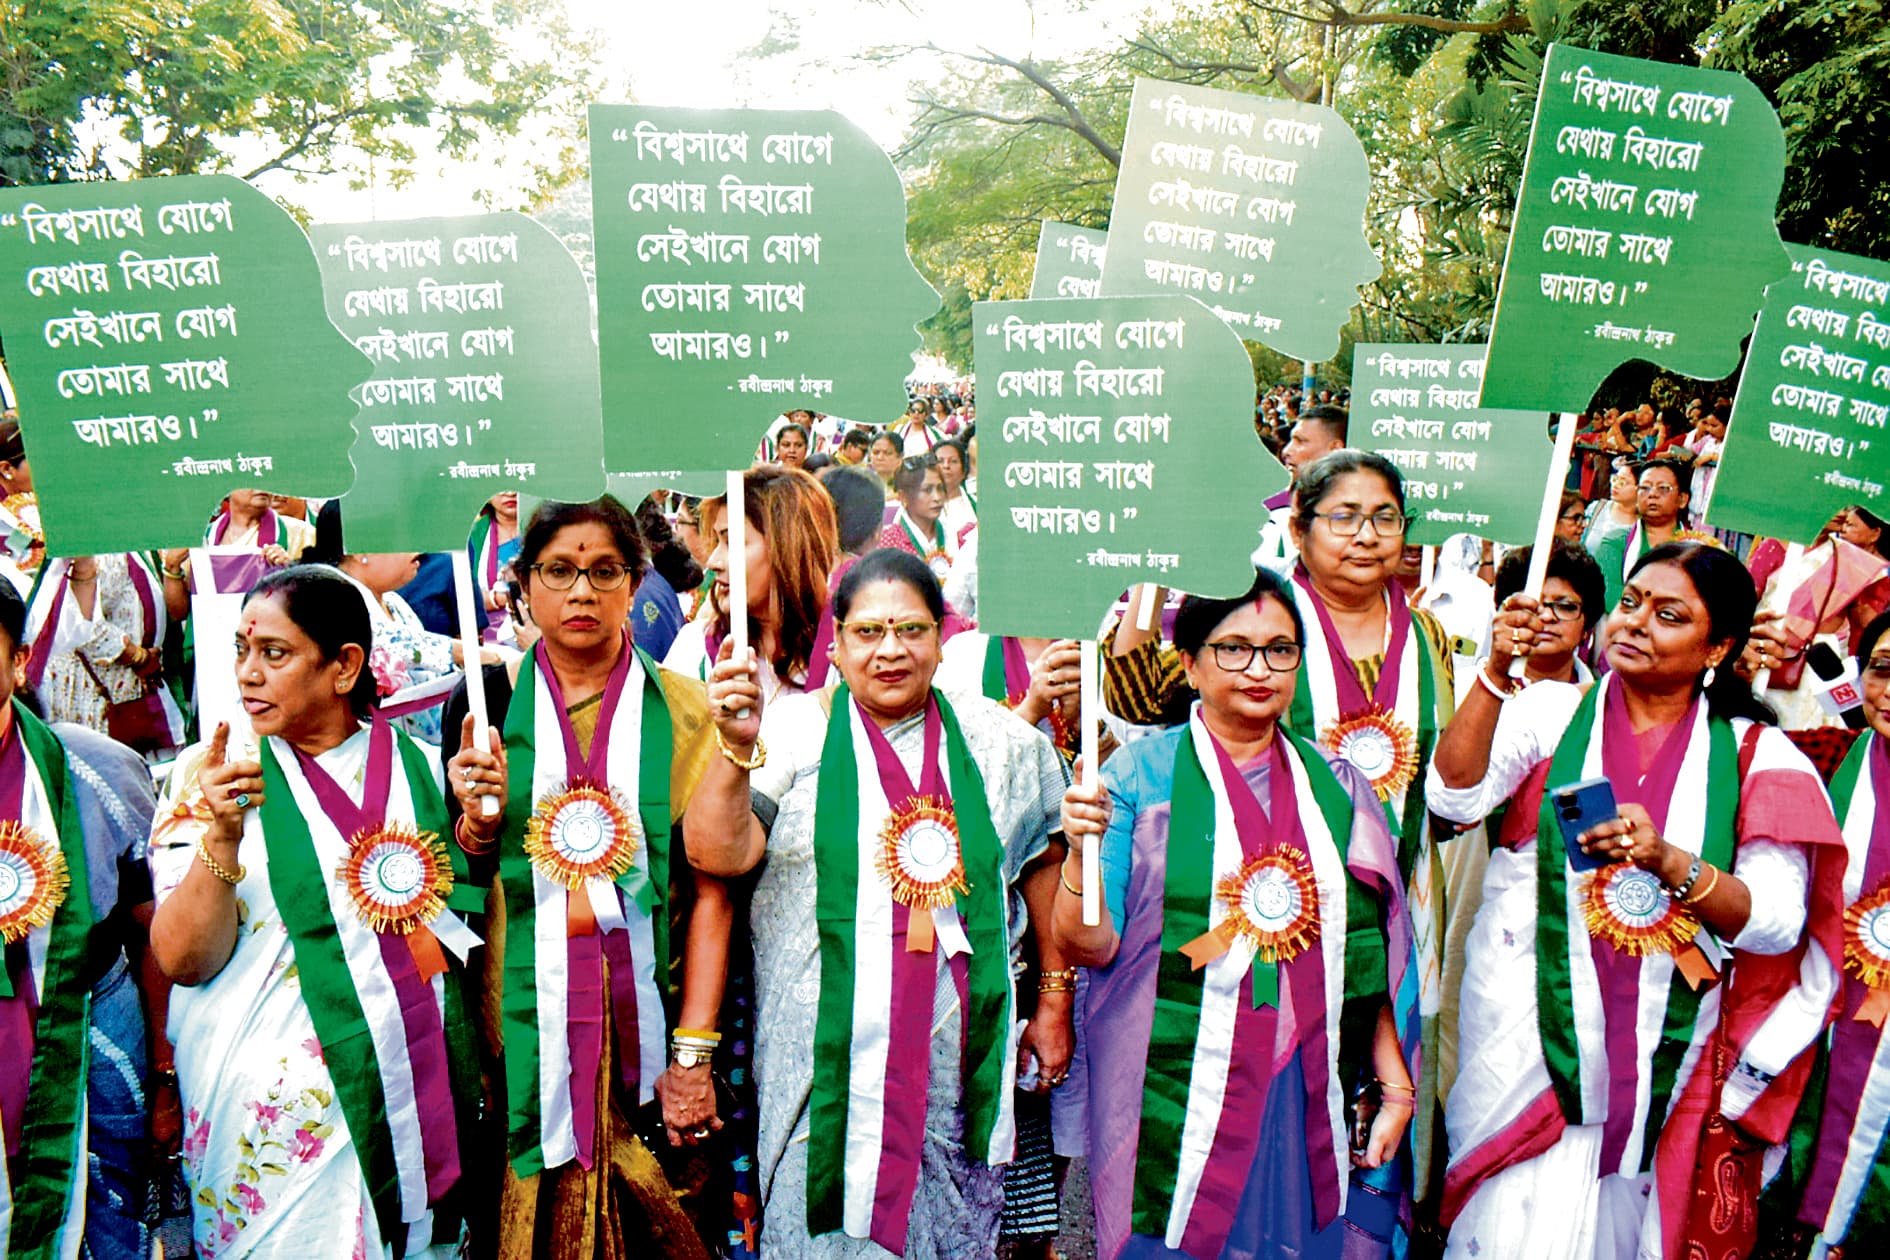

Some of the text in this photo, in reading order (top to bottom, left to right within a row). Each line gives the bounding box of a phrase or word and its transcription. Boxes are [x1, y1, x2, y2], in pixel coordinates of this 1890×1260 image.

[1667, 92, 1734, 126] যোগে
[762, 132, 834, 165] যোগে
[1556, 125, 1704, 172] যেথায় বিহারো
[628, 174, 814, 217] যেথায় বিহারো
[1550, 170, 1699, 220] সেইখানে যোগ
[157, 197, 234, 235] যোগে
[636, 224, 822, 266] সেইখানে যোগ
[1542, 225, 1673, 265] তোমার সাথে
[27, 249, 221, 297] যেথায় বিহারো
[641, 280, 806, 313] তোমার সাথে
[44, 303, 238, 349] সেইখানে যোগ
[1115, 317, 1186, 349] যোগে
[1594, 320, 1642, 342] রবীন্দ্রনাথ
[1644, 324, 1676, 349] ঠাকুর
[57, 356, 230, 399] তোমার সাথে
[737, 373, 796, 394] রবীন্দ্রনাথ
[799, 373, 833, 399] ঠাকুর
[996, 359, 1165, 399] যেথায় বিহারো
[1002, 407, 1172, 446] সেইখানে যোগ
[172, 456, 233, 476] রবীন্দ্রনাথ
[236, 452, 273, 477] ঠাকুর
[1004, 459, 1155, 490] তোমার সাথে
[1086, 547, 1142, 568] রবীন্দ্রনাথ
[1145, 548, 1180, 573] ঠাকুর
